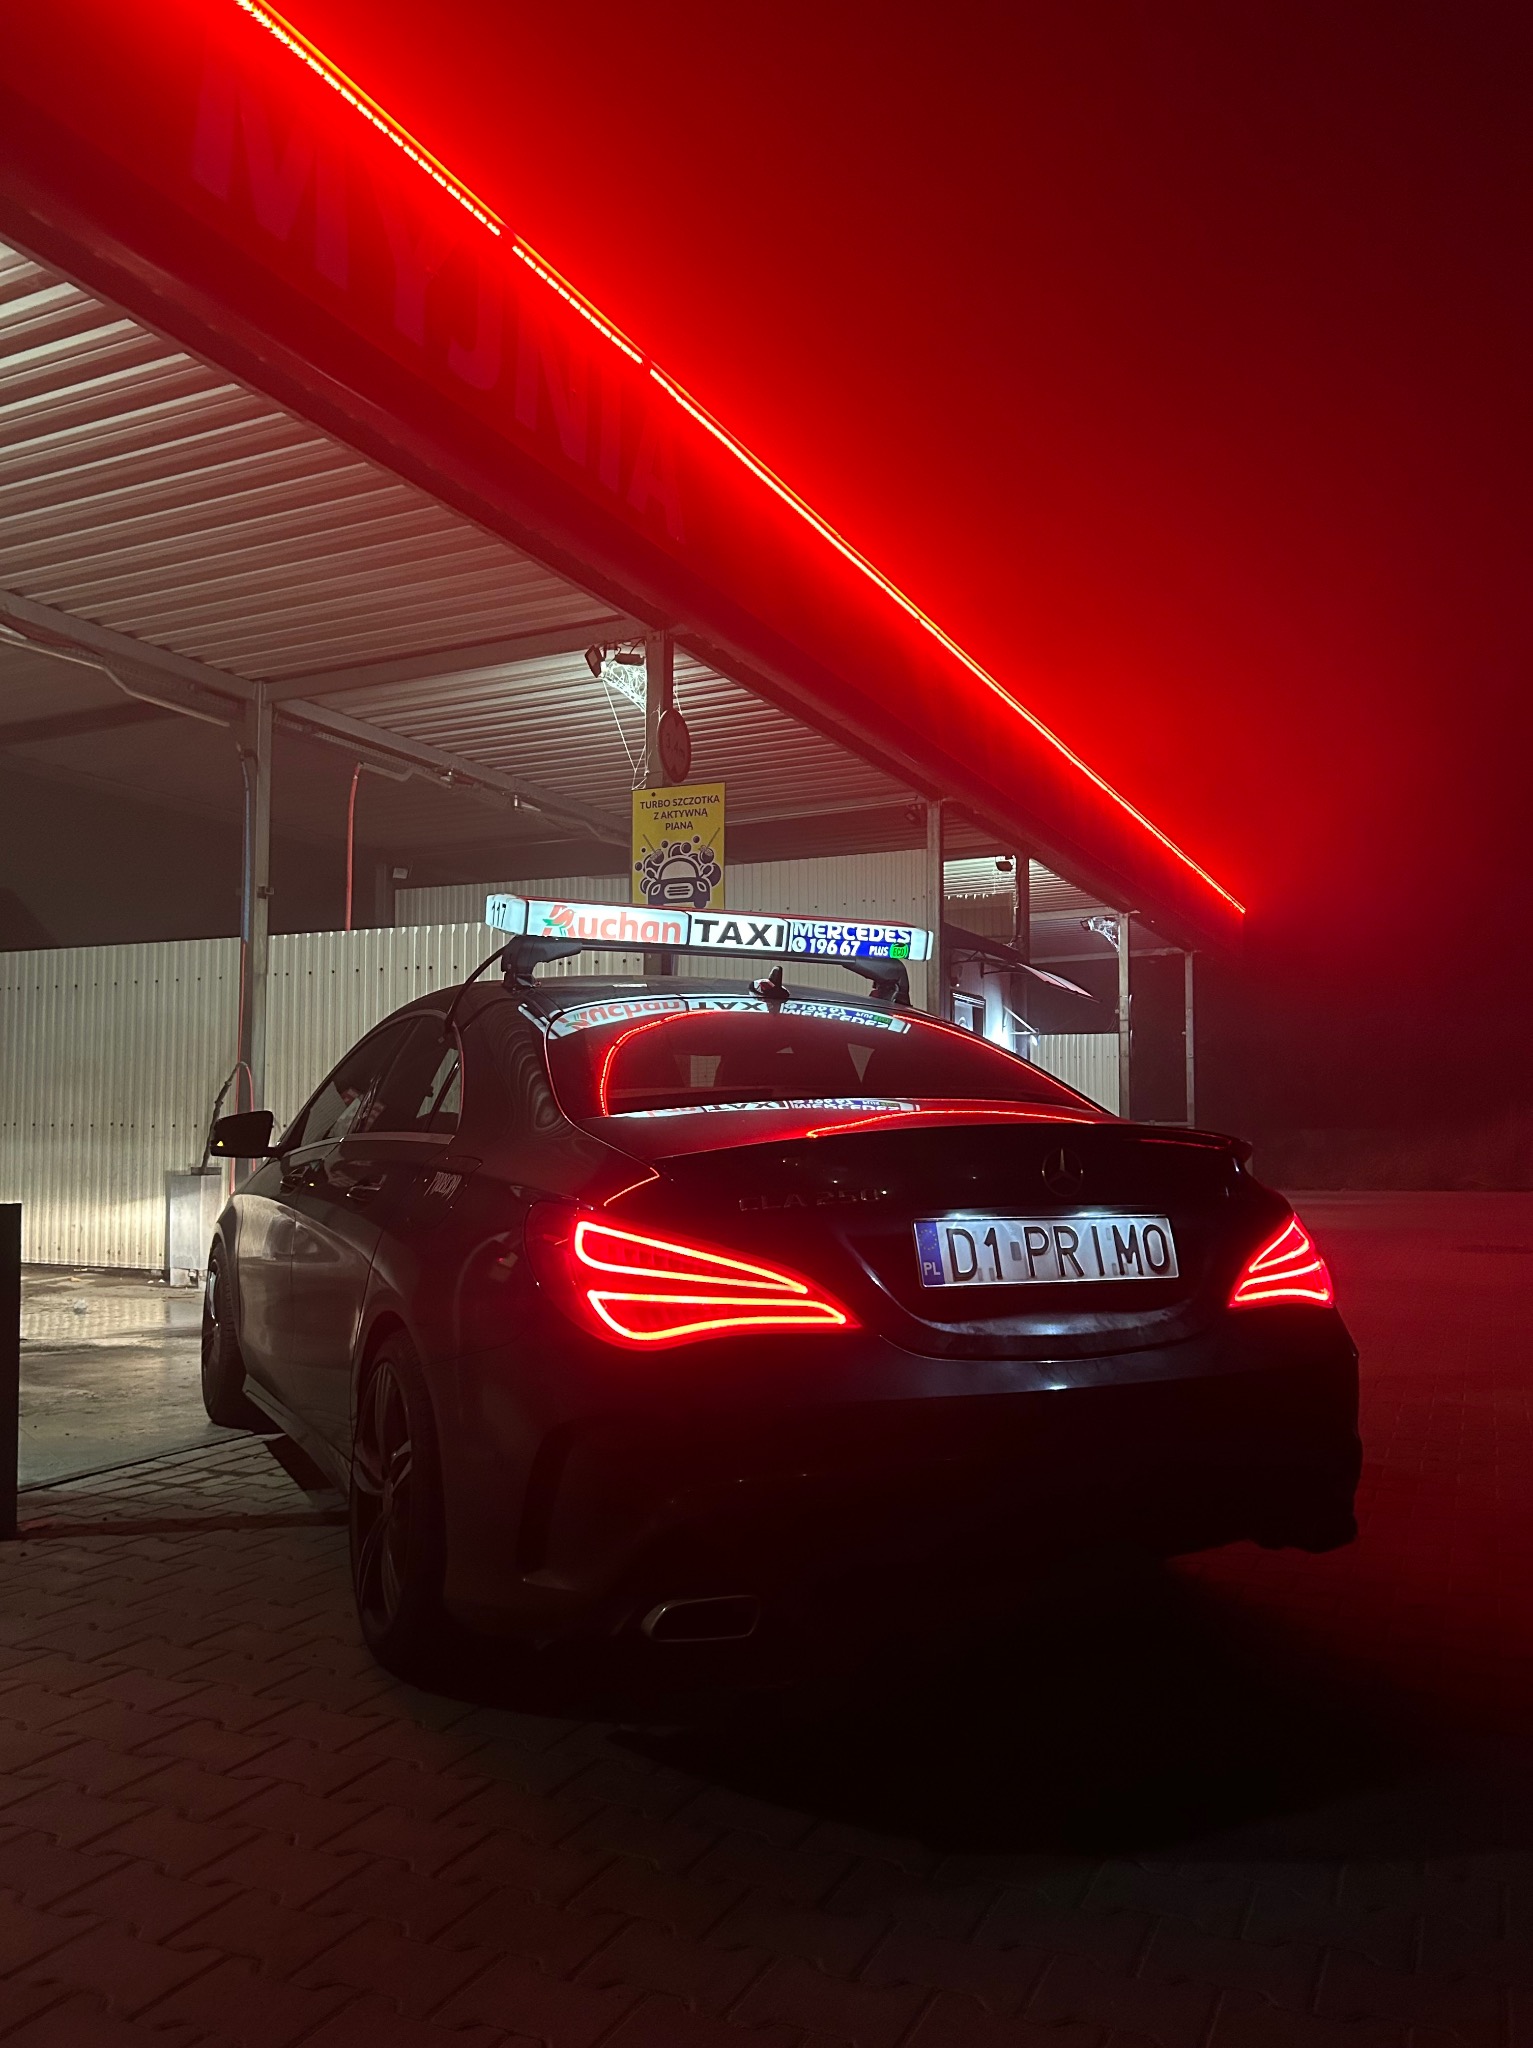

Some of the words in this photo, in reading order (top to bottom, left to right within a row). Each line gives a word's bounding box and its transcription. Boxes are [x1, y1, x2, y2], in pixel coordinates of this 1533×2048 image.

[190, 50, 687, 545] MYJNIA
[640, 799, 671, 809] TURBO
[672, 795, 720, 807] SZCZOTKA
[653, 812, 659, 820] Z
[661, 808, 708, 819] AKTYWNĄ
[665, 821, 694, 831] PIANĄ
[491, 901, 507, 928] 117
[542, 905, 682, 944] Auchan
[694, 918, 785, 947] TAXI
[793, 922, 912, 943] MERCEDES
[869, 945, 889, 956] PLUS
[738, 1194, 809, 1212] CLA
[946, 1226, 1004, 1282] D1
[1023, 1223, 1171, 1278] PRIMO
[923, 1261, 941, 1276] PL
